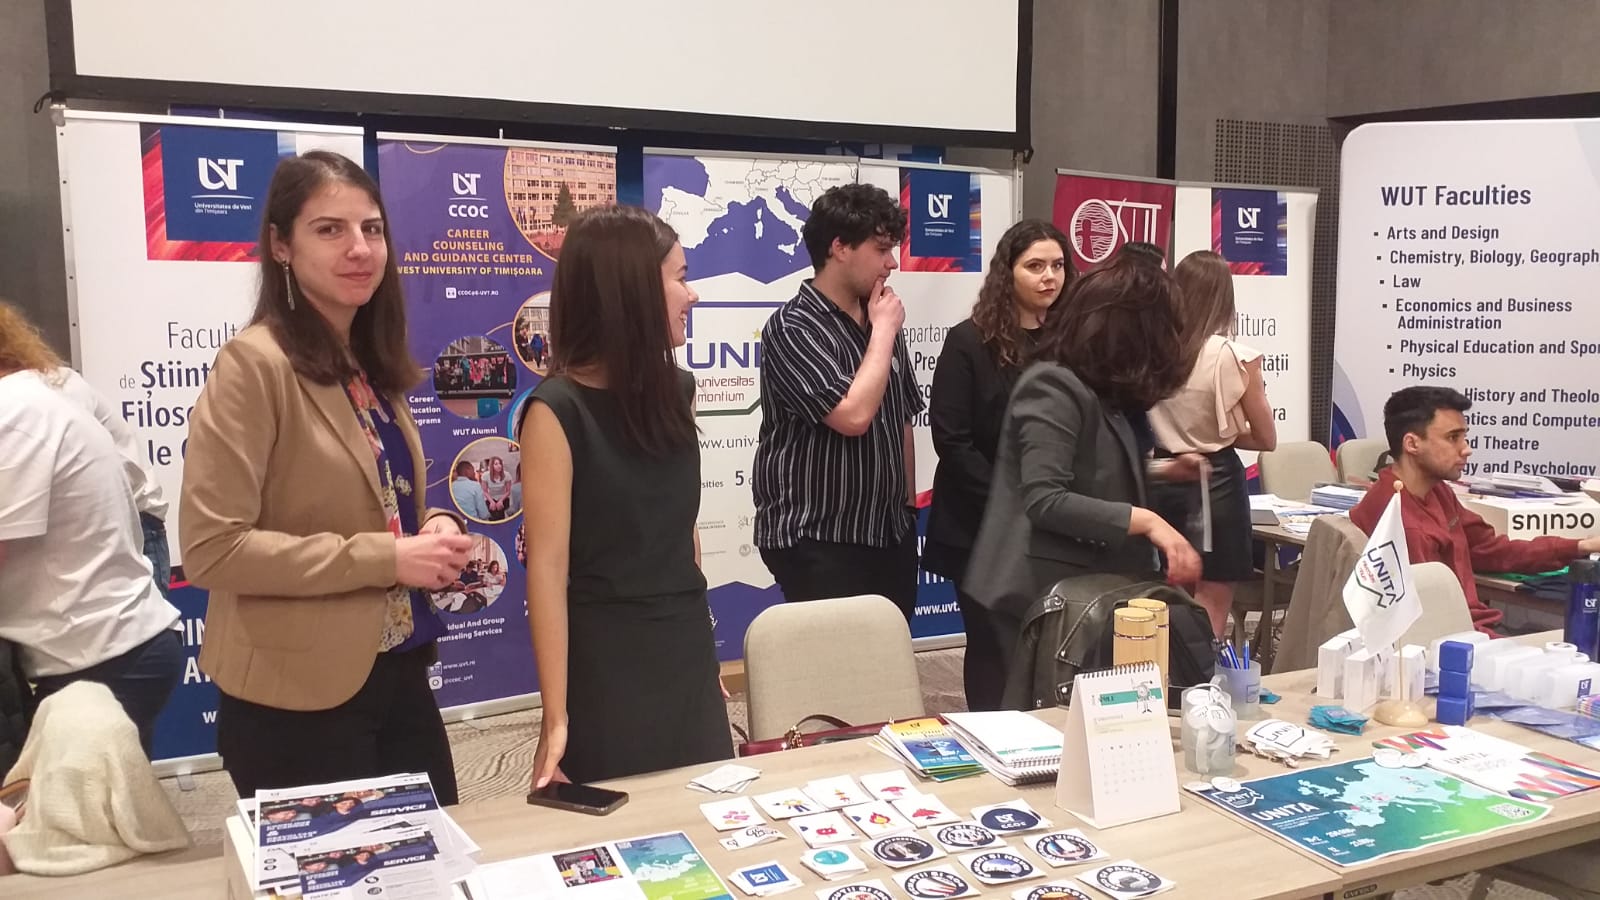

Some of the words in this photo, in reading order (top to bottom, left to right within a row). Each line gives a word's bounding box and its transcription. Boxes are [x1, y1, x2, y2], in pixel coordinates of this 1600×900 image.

[1381, 186, 1427, 206] WUT
[1435, 184, 1531, 205] Faculties
[448, 204, 489, 218] CCOC
[447, 229, 490, 239] CAREER
[1387, 226, 1417, 240] Arts
[1421, 226, 1447, 240] and
[1451, 225, 1499, 242] Design
[433, 240, 504, 251] COUNSELING
[404, 252, 429, 262] AND
[432, 253, 490, 263] GUIDANCE
[493, 254, 533, 264] CENTER
[1390, 250, 1465, 267] Chemistry,
[1470, 250, 1525, 266] Biology,
[1530, 249, 1600, 266] Geograph
[422, 266, 477, 275] UNIVERSITY
[480, 267, 492, 275] OF
[1393, 274, 1421, 288] Law
[1396, 298, 1472, 312] Economics
[1476, 298, 1502, 312] and
[1507, 298, 1573, 312] Business
[1398, 315, 1502, 329] Administration
[687, 342, 760, 369] UNI
[1400, 340, 1459, 357] Physical
[1464, 340, 1535, 354] Education
[1539, 340, 1566, 354] and
[914, 351, 936, 371] Pre
[1402, 364, 1457, 380] Physics
[119, 373, 136, 389] de
[697, 376, 755, 387] universitas
[409, 395, 434, 403] Career
[697, 391, 745, 402] montium
[1464, 388, 1515, 405] History
[1520, 388, 1546, 402] and
[1502, 413, 1528, 426] and
[471, 427, 498, 435] Alumni
[1483, 436, 1539, 450] Theatre
[1483, 460, 1509, 473] and
[1514, 460, 1597, 476] Psychology
[735, 470, 744, 486] 5
[1512, 512, 1595, 535] oculus
[467, 619, 481, 627] And
[482, 617, 505, 625] Group
[473, 627, 503, 638] Services
[1251, 802, 1320, 820] UNITA
